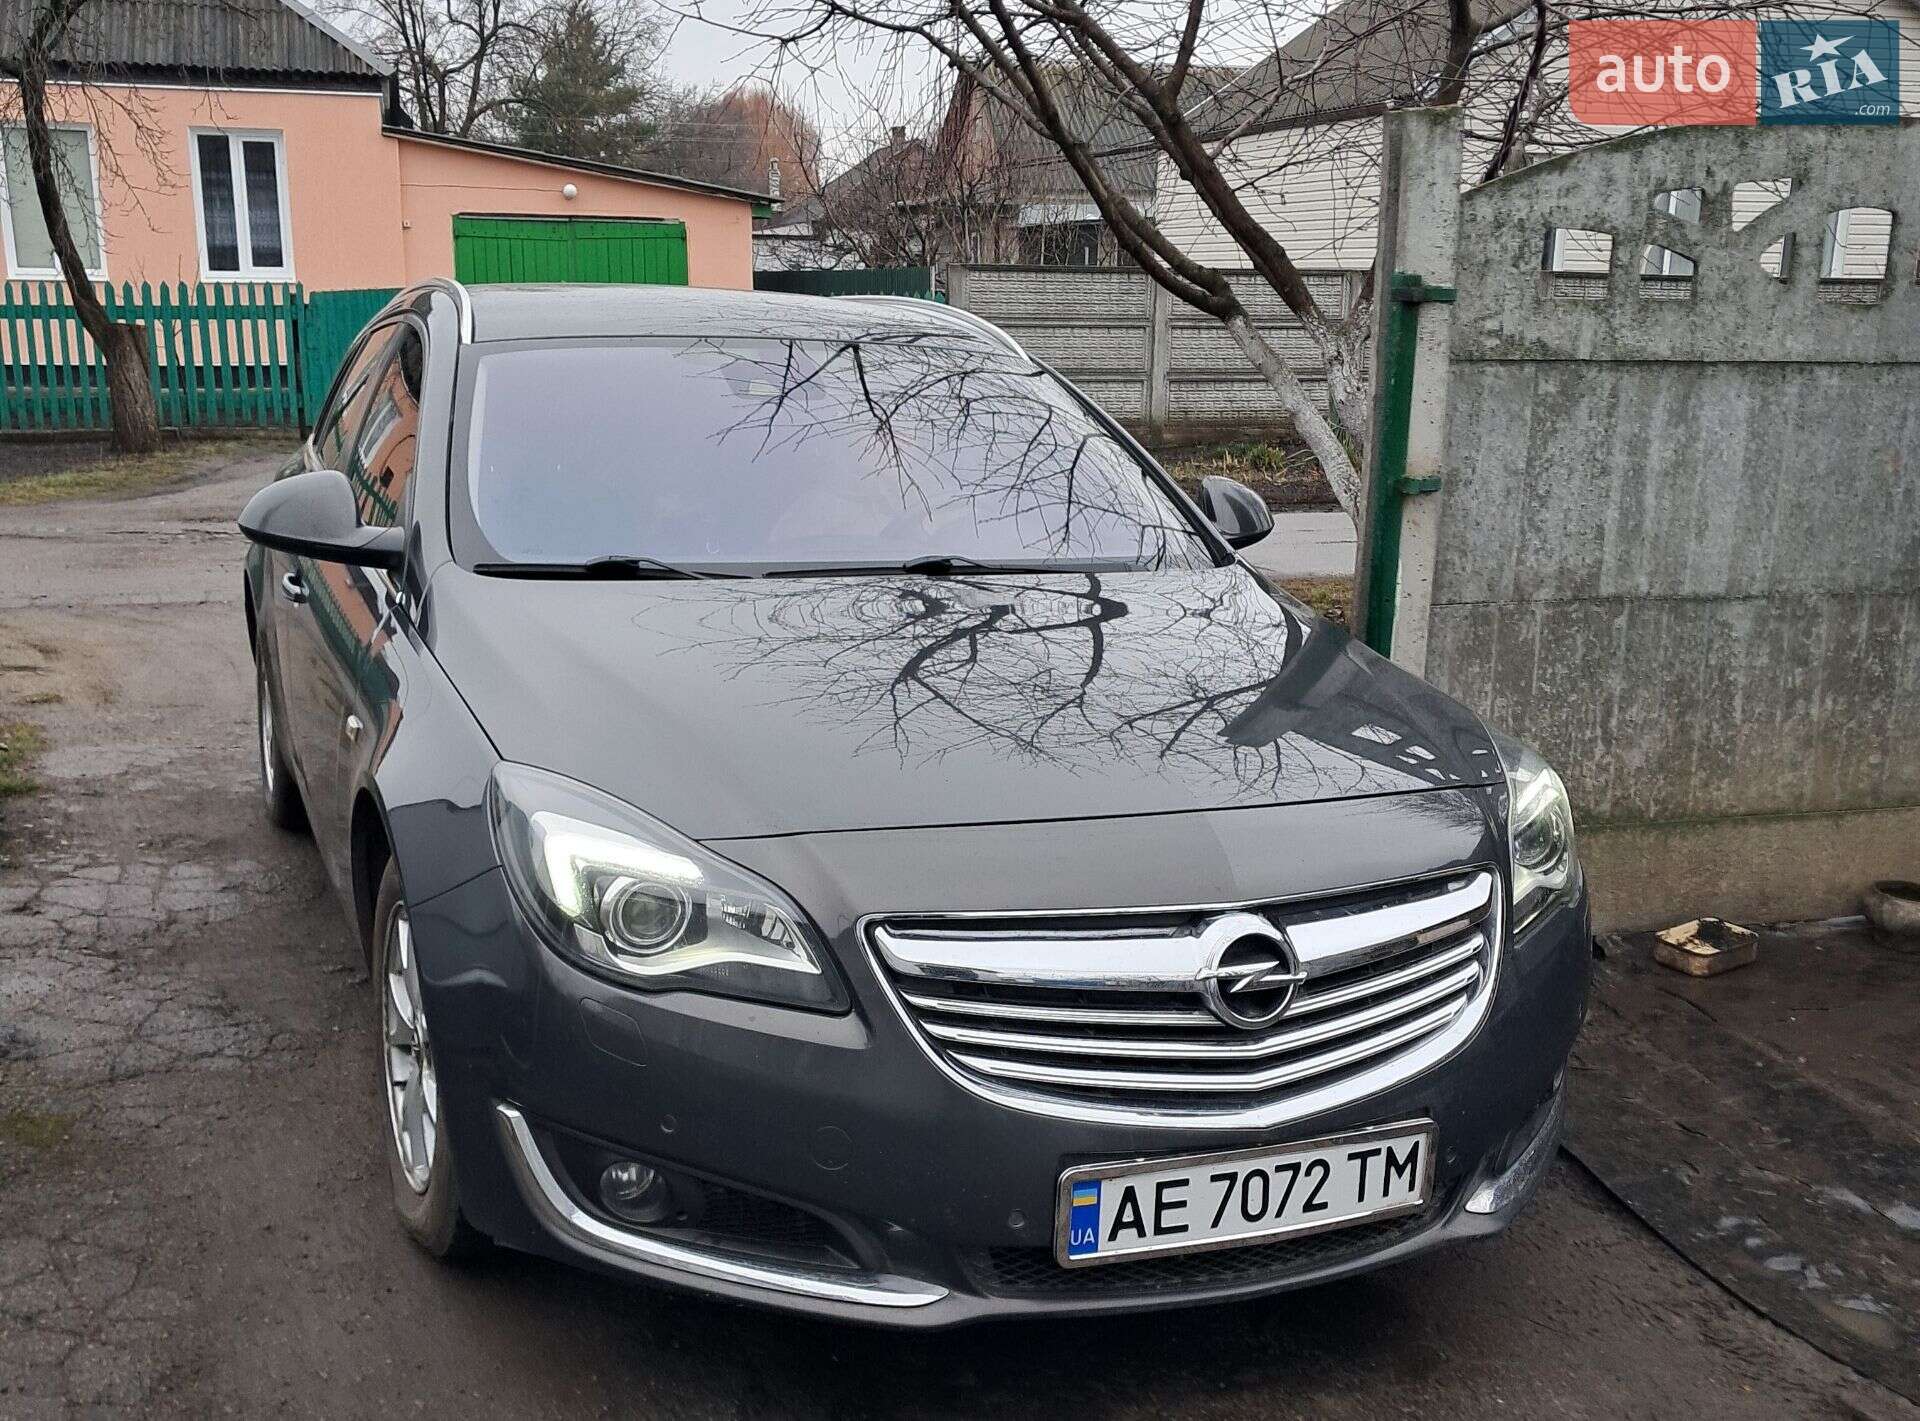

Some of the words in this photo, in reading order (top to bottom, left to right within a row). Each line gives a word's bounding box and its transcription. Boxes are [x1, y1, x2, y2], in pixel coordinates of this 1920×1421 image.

[1107, 1178, 1190, 1242] AE
[1209, 1158, 1331, 1229] 7072
[1347, 1140, 1421, 1203] TM
[1070, 1228, 1095, 1246] UA
